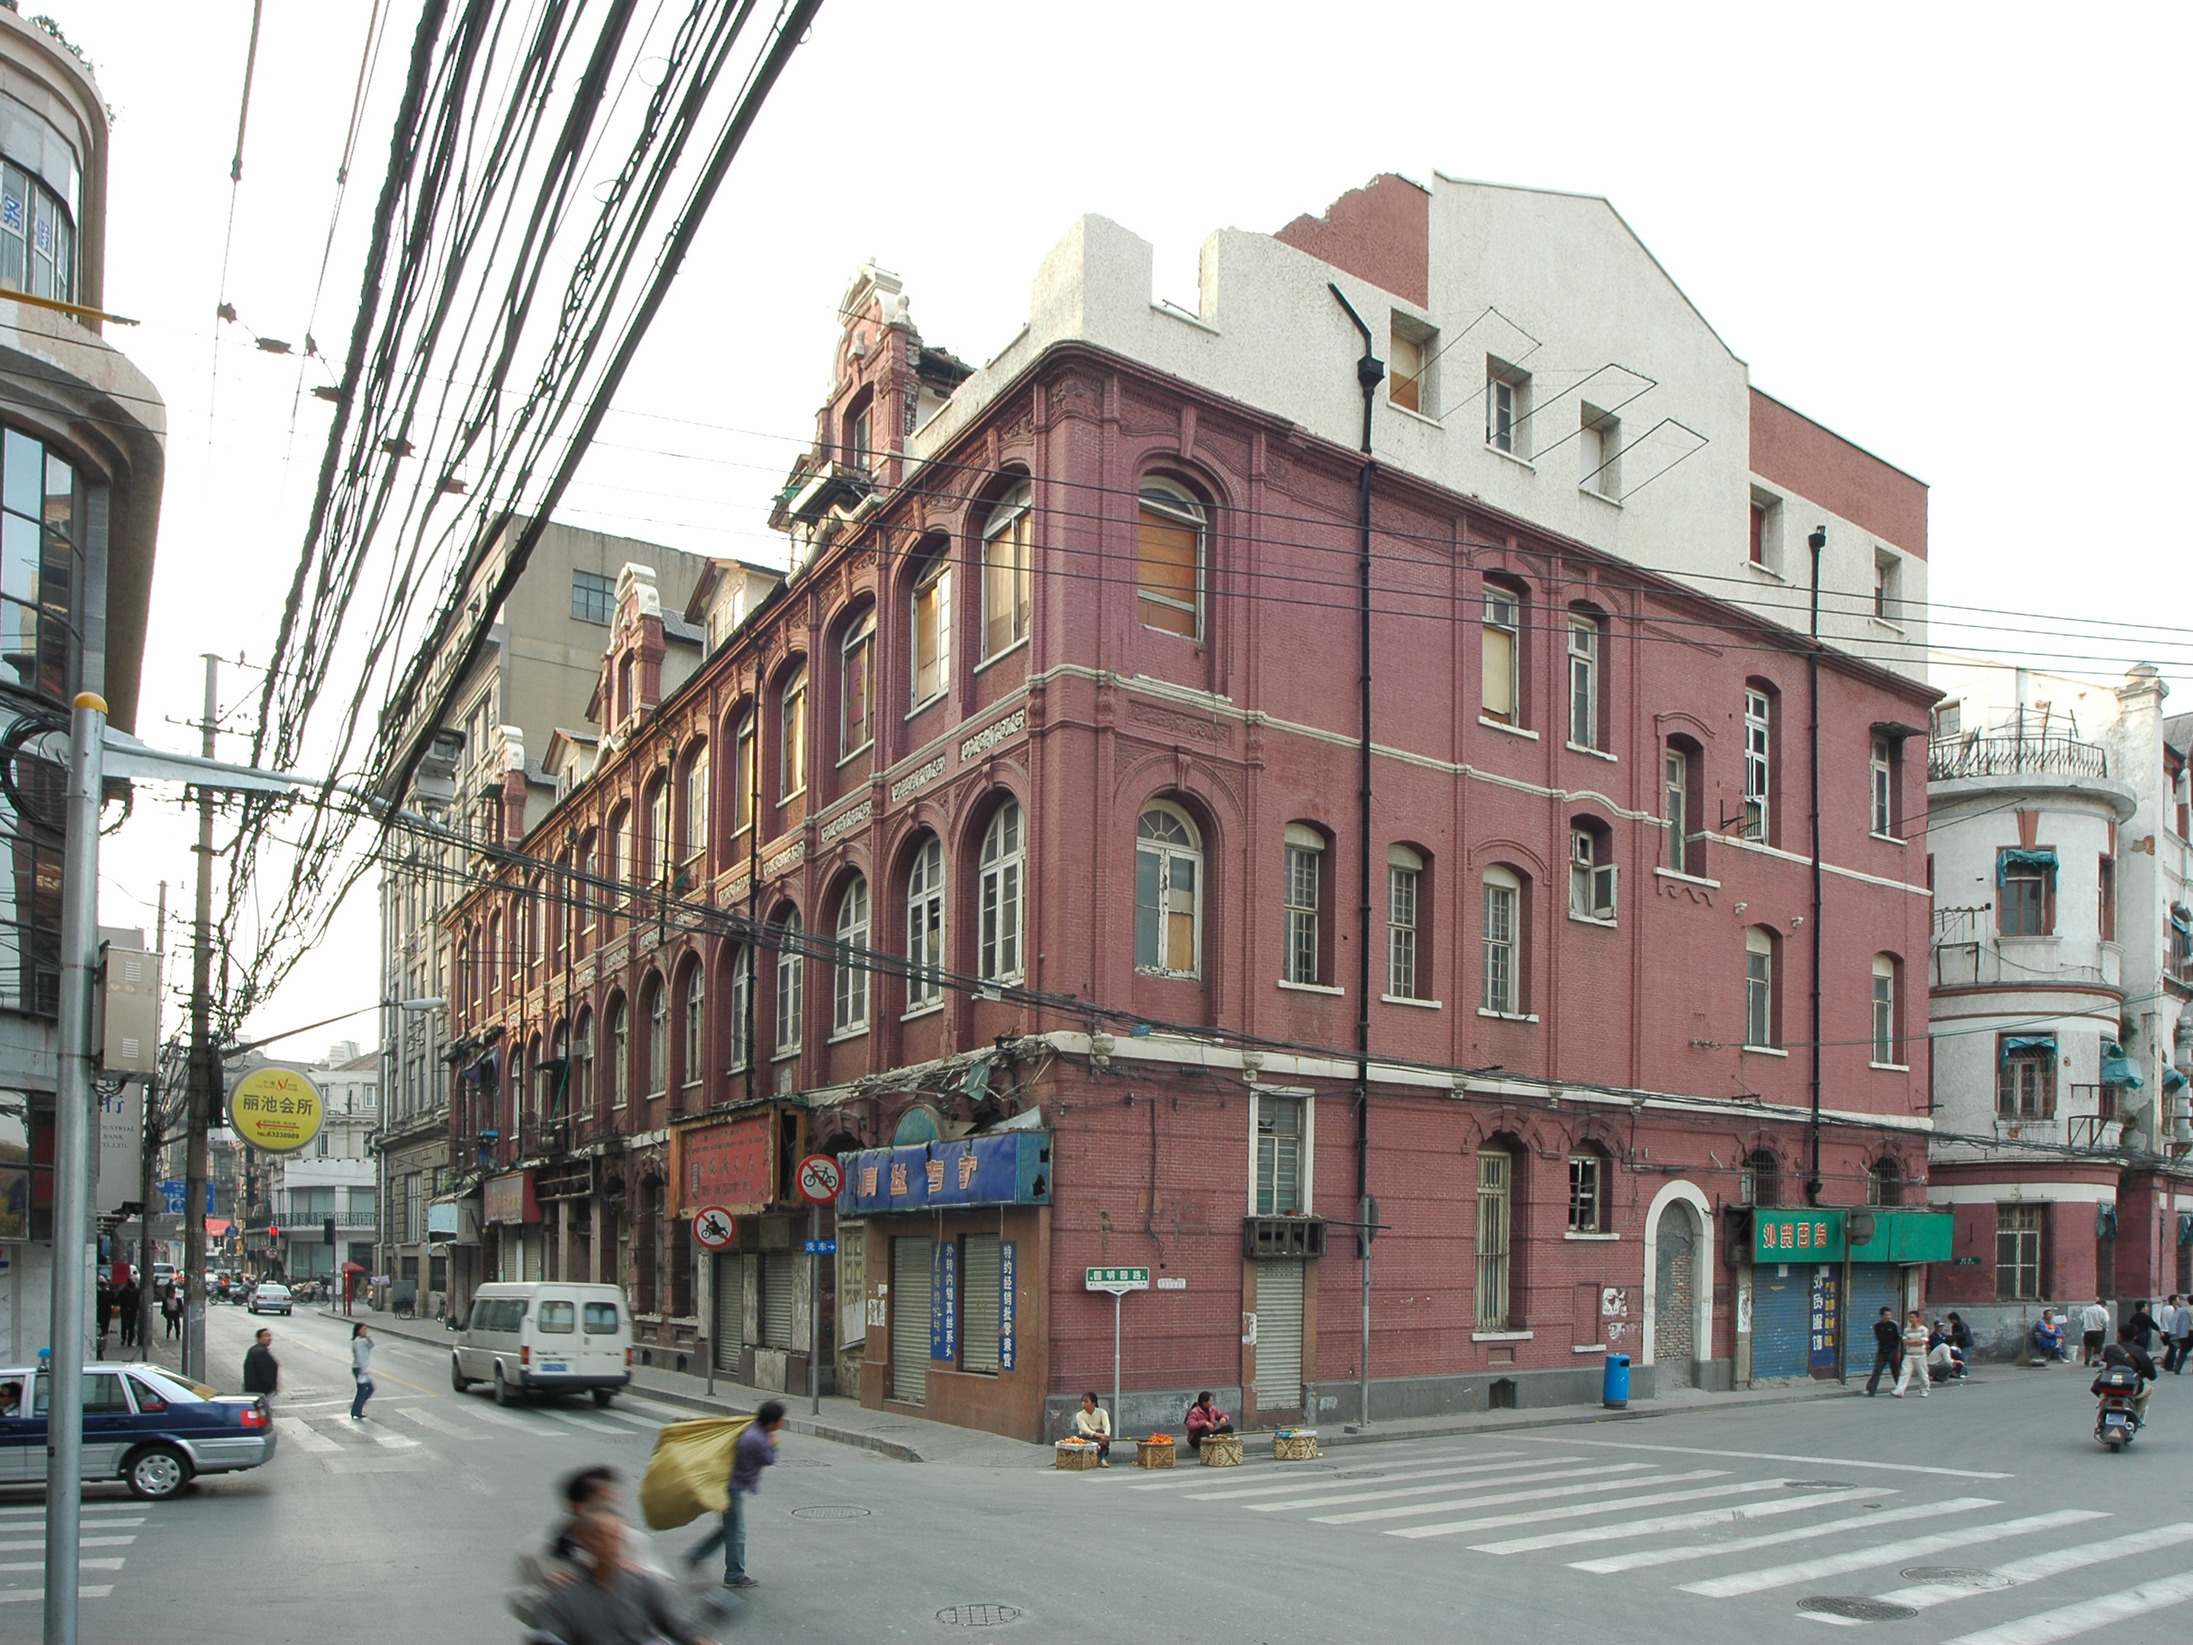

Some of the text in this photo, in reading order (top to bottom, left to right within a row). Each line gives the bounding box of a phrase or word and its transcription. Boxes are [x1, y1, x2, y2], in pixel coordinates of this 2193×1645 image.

[243, 1094, 313, 1115] 丽池会所
[1763, 1222, 1827, 1249] 外贸百货
